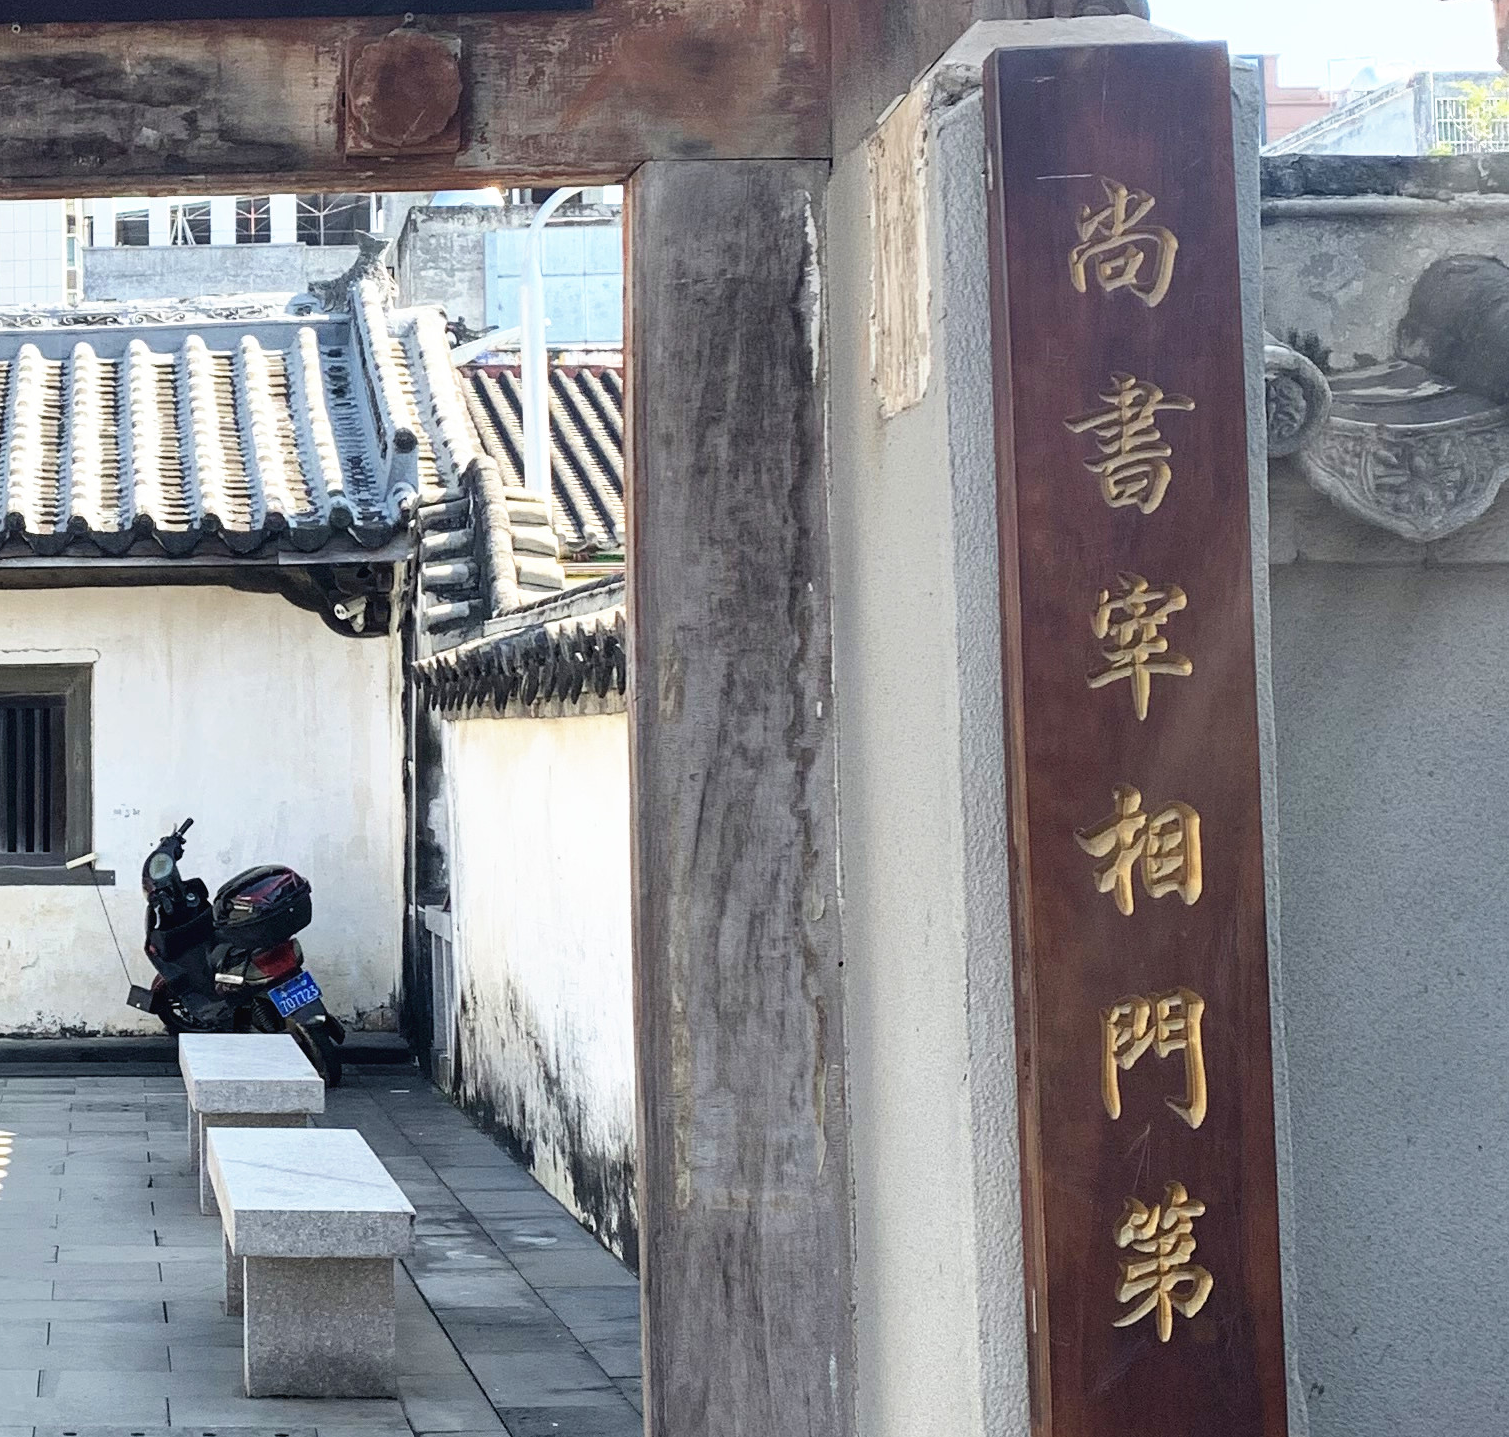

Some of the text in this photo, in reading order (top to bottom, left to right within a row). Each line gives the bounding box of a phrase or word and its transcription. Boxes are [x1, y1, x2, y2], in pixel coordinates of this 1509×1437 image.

[279, 985, 319, 1013] 707723
[1063, 175, 1214, 1343] 尚書宰相門第
